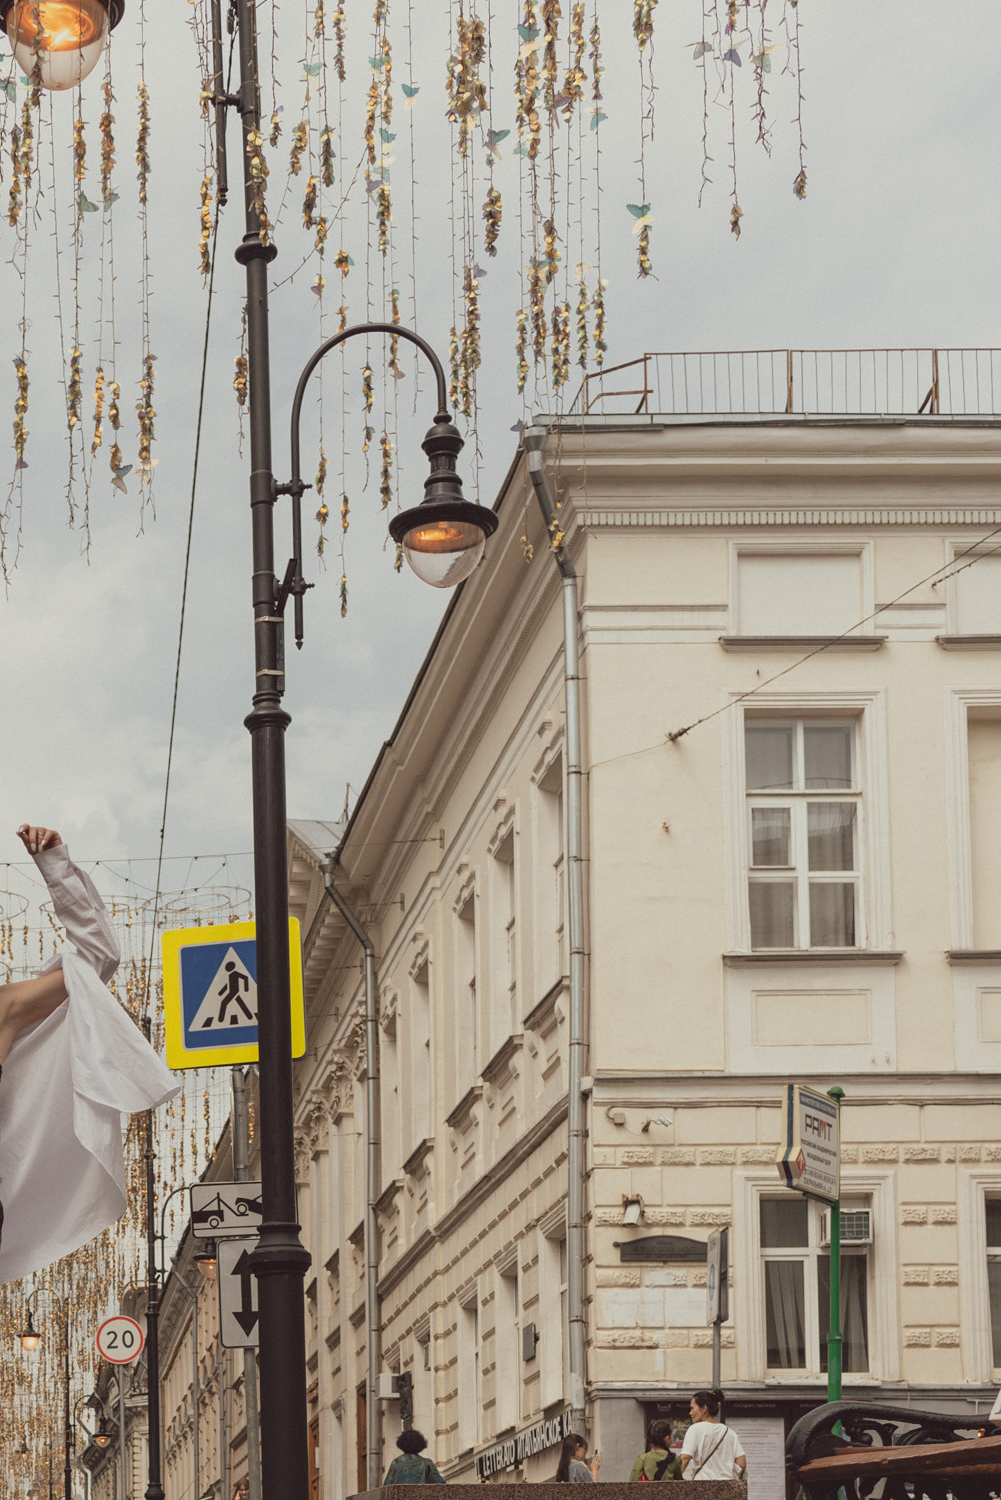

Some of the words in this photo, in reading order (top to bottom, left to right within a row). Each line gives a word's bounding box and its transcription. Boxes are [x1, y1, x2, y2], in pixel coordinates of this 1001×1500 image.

[805, 1113, 832, 1141] РАМТ
[107, 1330, 134, 1349] 20
[483, 1439, 516, 1477] LETTERATO
[517, 1415, 562, 1460] ИТАЛЬЯНСКОЕ
